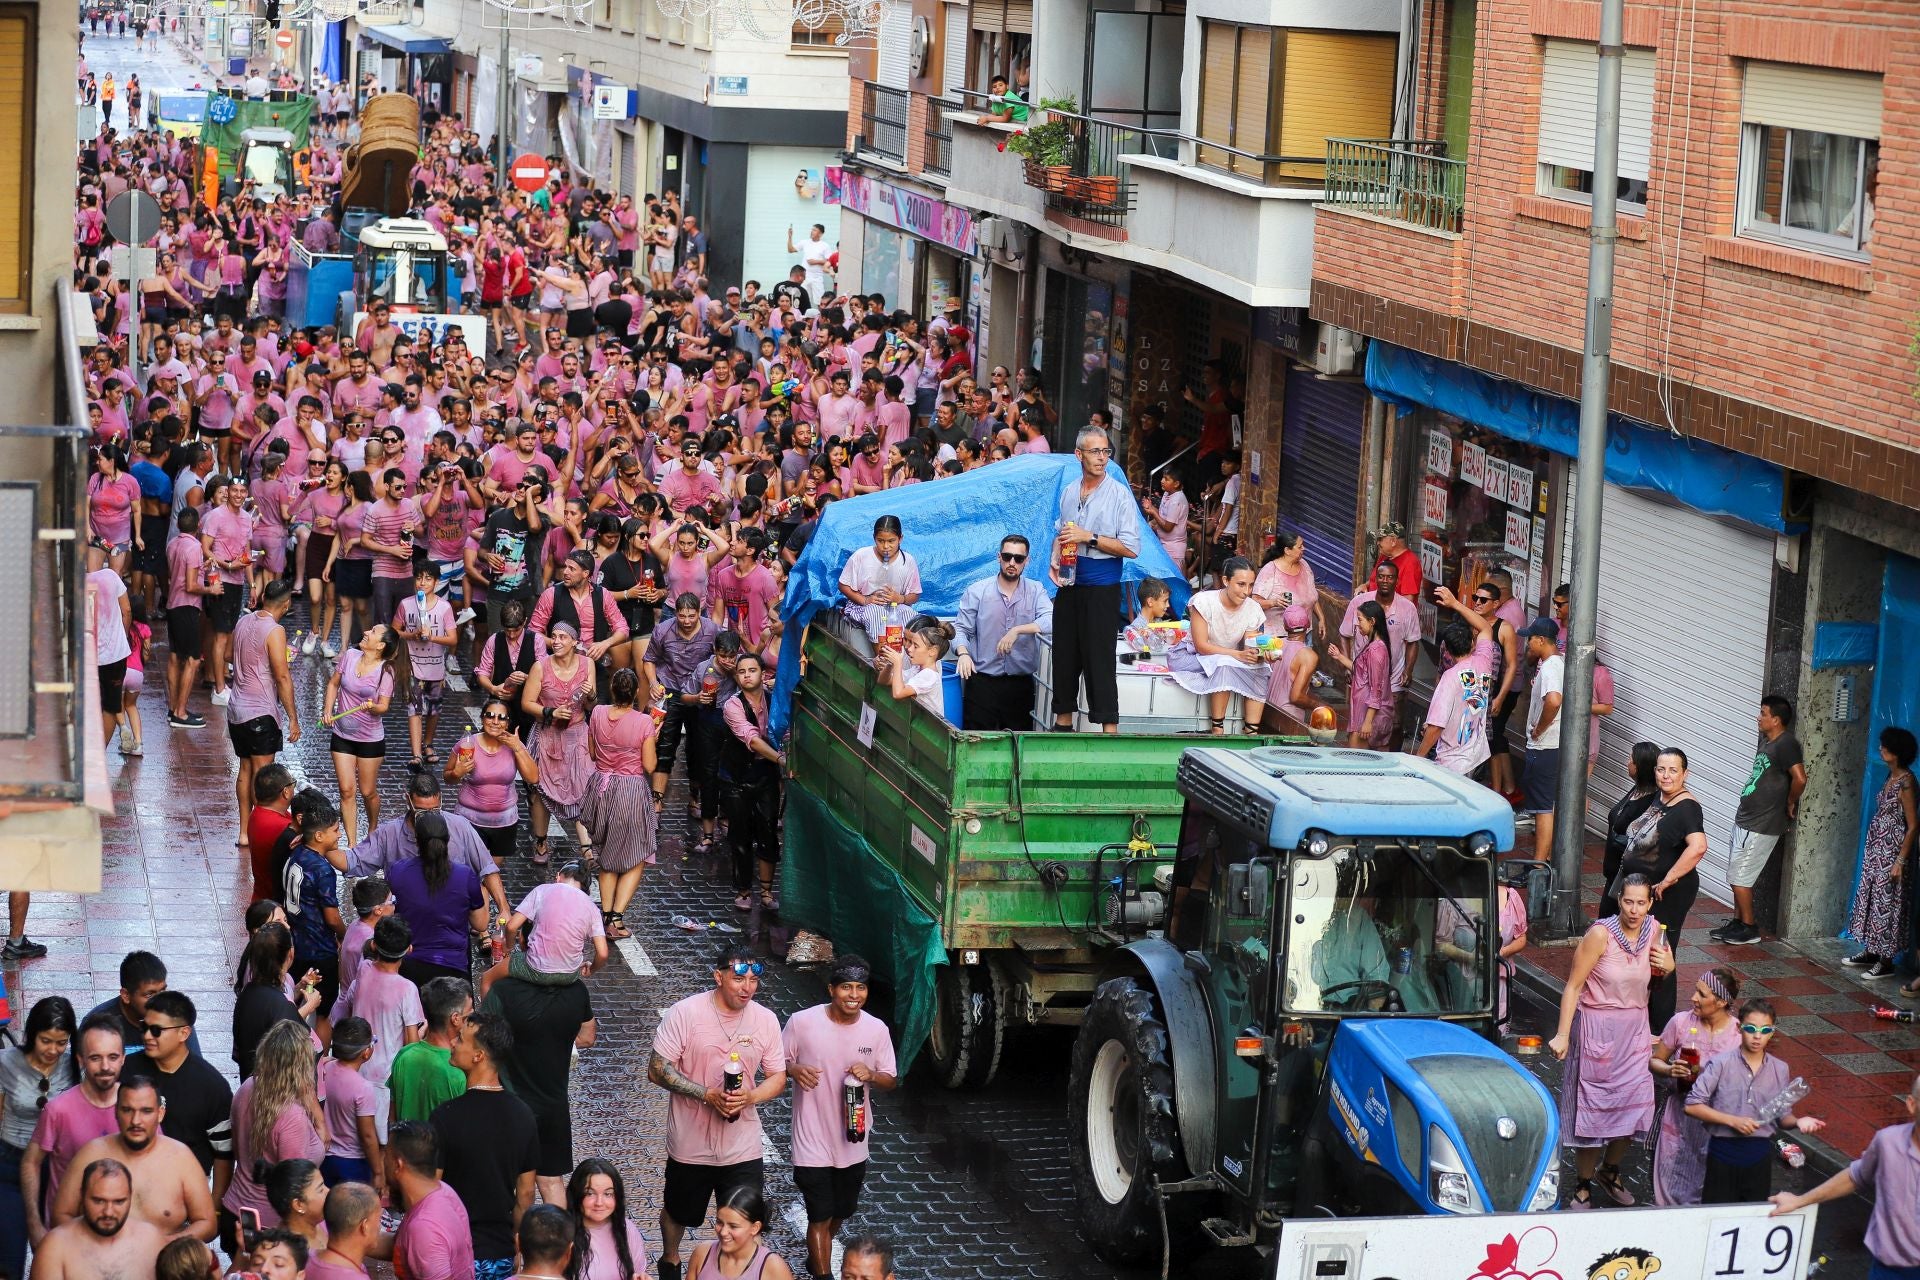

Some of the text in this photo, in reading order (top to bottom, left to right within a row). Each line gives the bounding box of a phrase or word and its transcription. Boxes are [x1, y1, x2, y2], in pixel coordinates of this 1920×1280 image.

[906, 195, 931, 231] 2000
[1430, 446, 1439, 468] 50
[1510, 480, 1520, 503] 50
[1331, 1079, 1360, 1130] NEW HOLLAND
